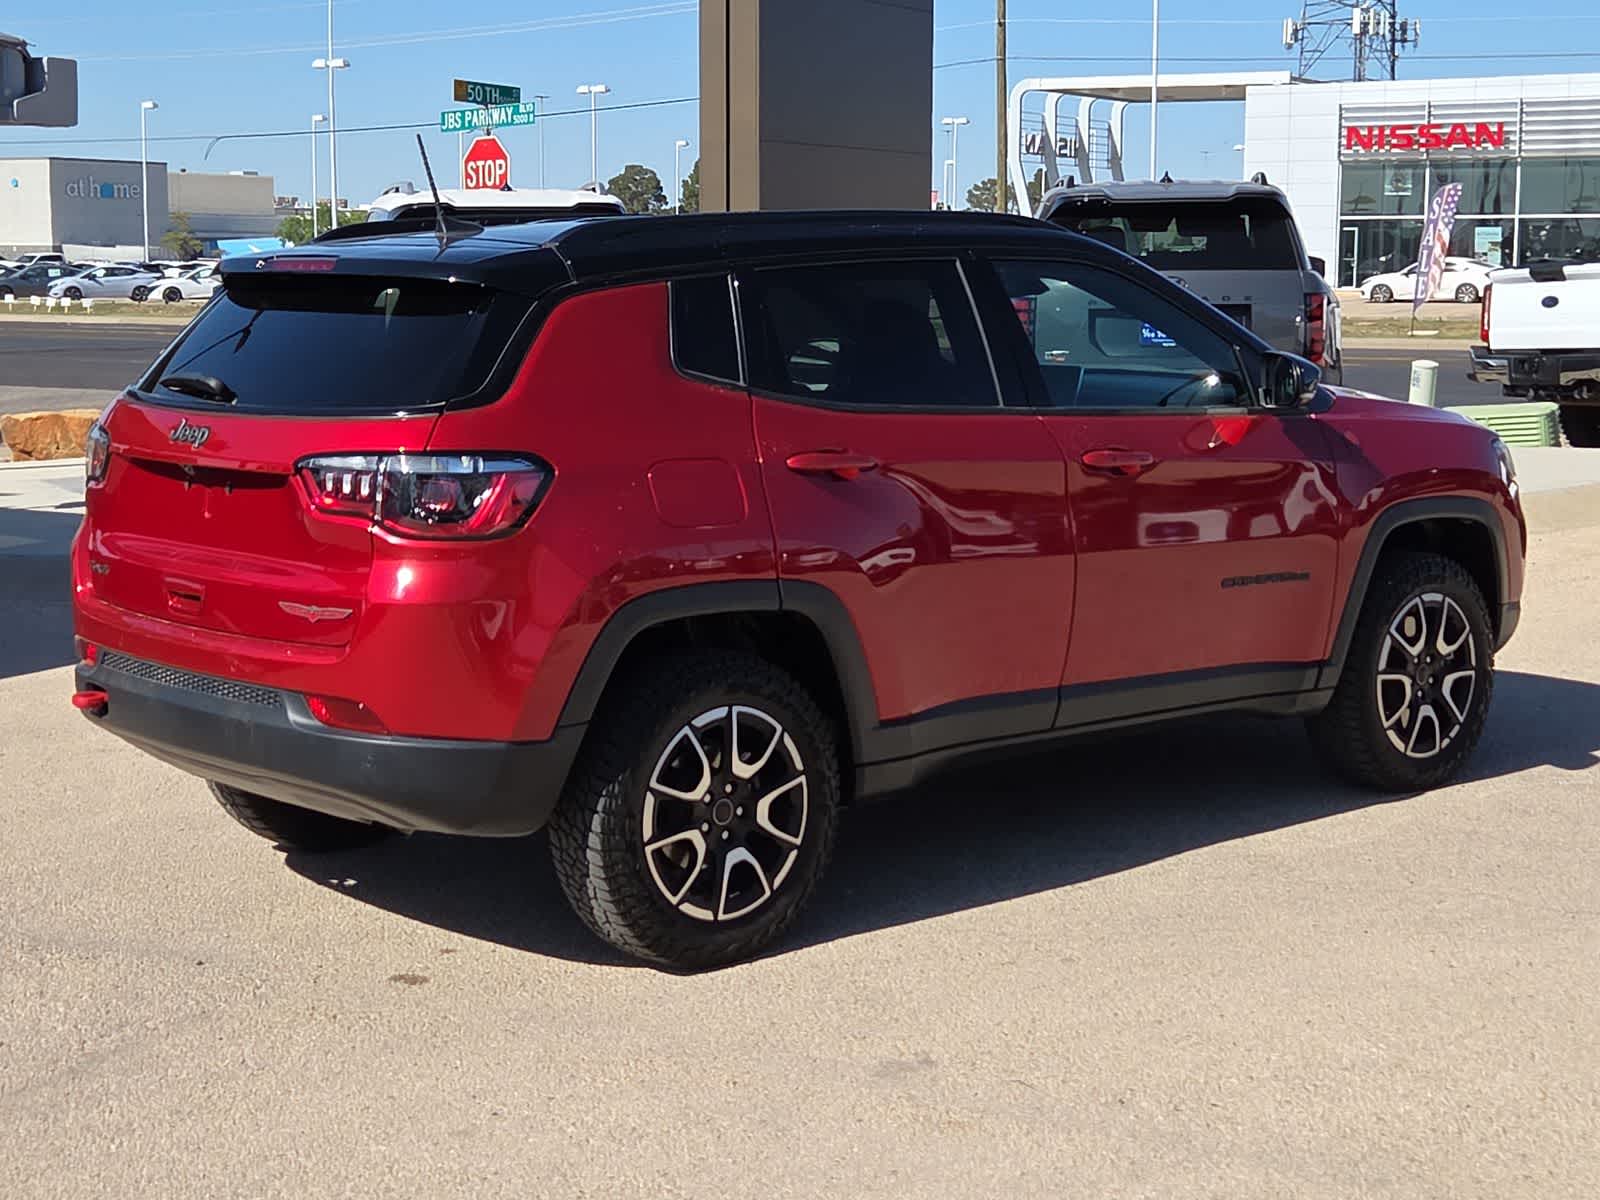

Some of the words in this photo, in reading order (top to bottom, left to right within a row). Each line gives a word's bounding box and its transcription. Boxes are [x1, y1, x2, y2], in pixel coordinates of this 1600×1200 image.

[442, 113, 462, 129] JBS
[464, 106, 514, 127] PARKWAY
[1345, 122, 1504, 151] NISSAN
[466, 159, 505, 188] STOP
[66, 180, 86, 198] at
[1416, 197, 1441, 299] SALE
[170, 418, 210, 449] Jeep
